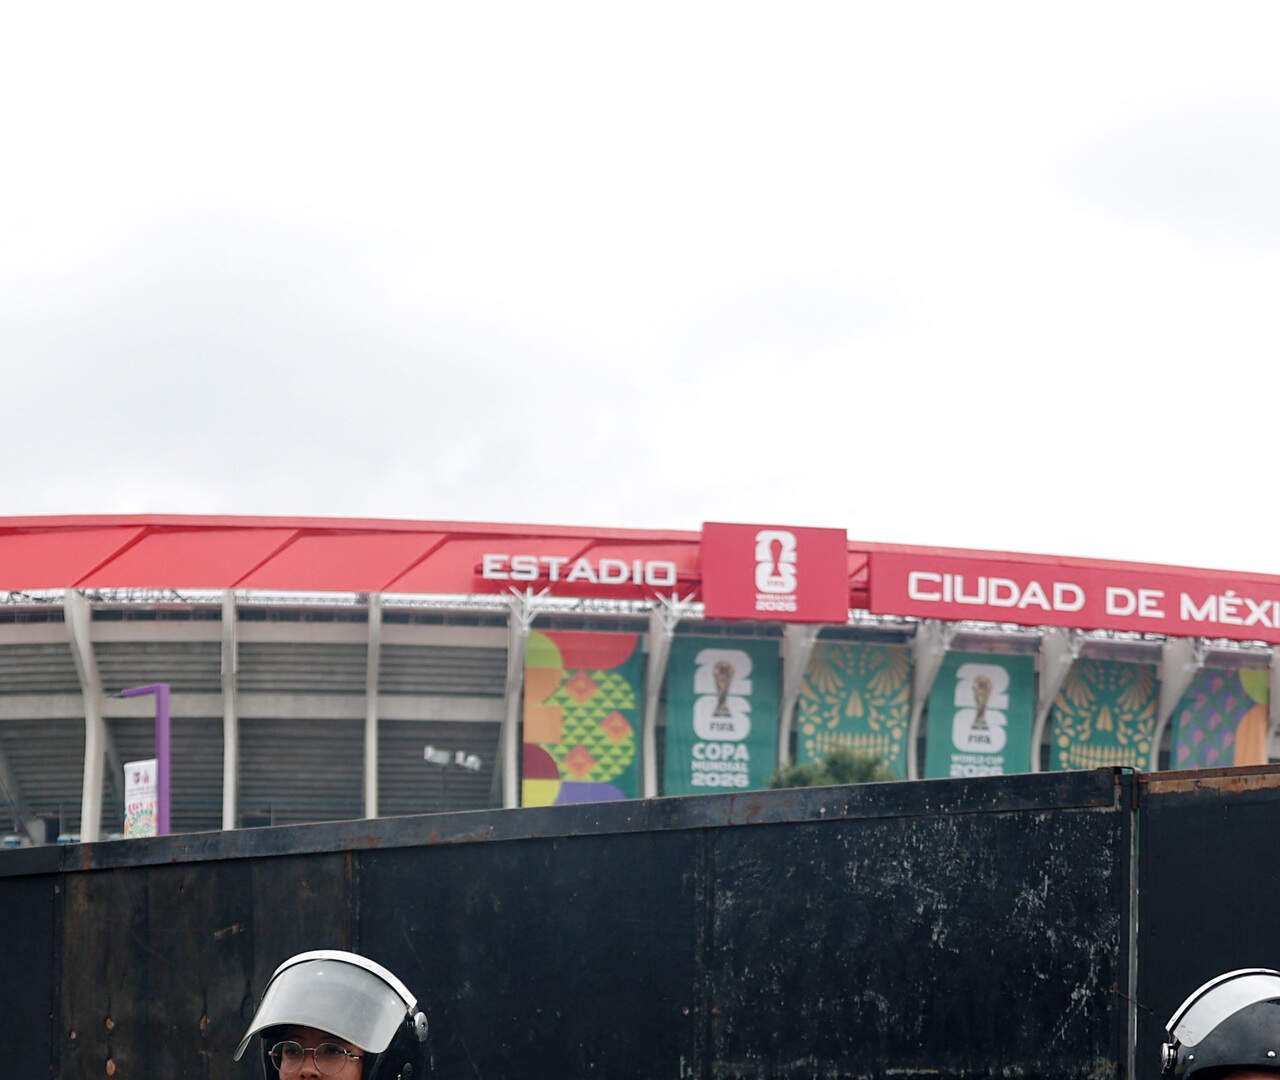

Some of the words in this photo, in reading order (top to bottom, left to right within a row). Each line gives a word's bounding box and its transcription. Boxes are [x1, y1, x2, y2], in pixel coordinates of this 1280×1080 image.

[482, 553, 678, 586] ESTADIO
[907, 571, 1086, 612] CIUDAD
[1105, 586, 1166, 618] DE
[709, 721, 736, 732] FIFA
[691, 742, 750, 761] COPA
[690, 760, 749, 773] MUNDIAL
[691, 772, 750, 788] 2026
